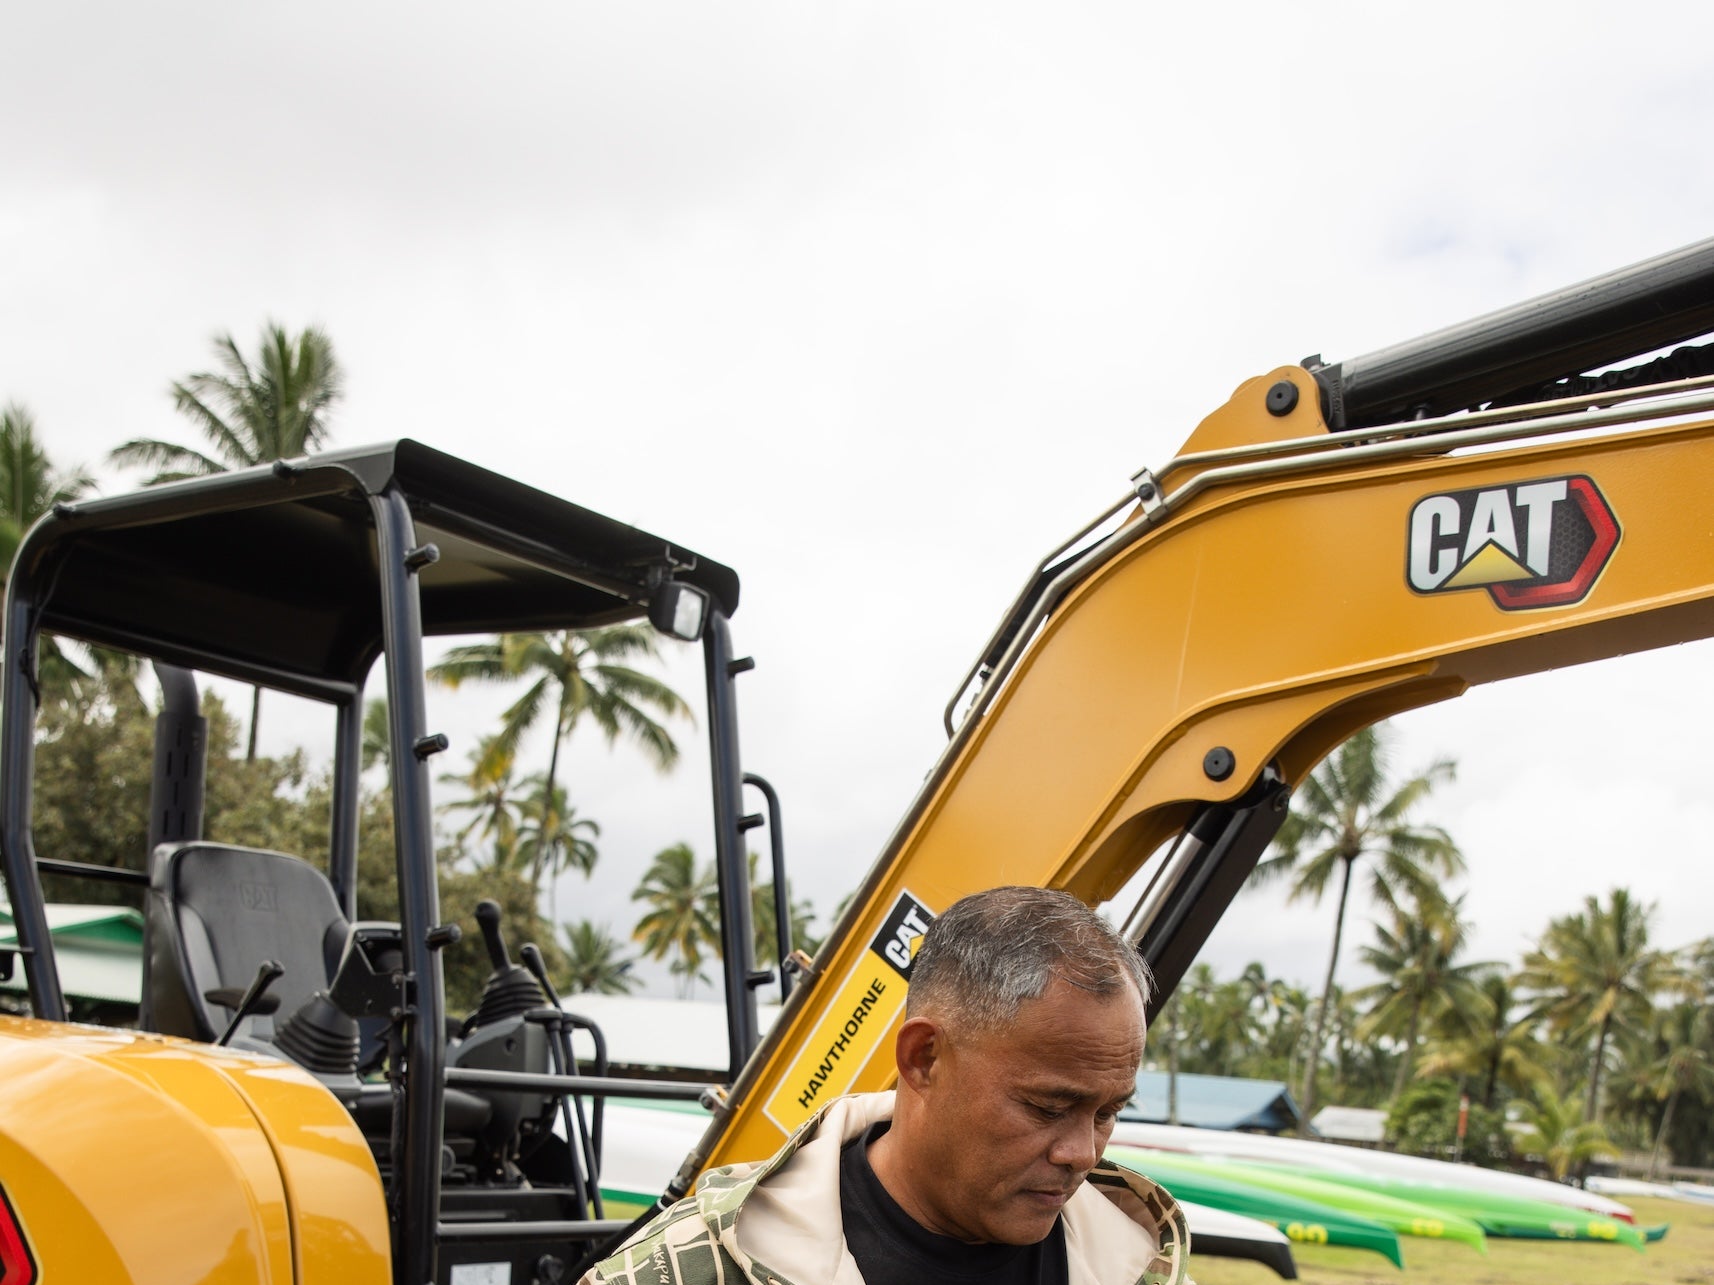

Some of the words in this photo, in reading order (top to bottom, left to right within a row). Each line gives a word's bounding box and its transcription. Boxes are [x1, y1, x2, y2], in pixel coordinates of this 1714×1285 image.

[1410, 480, 1567, 590] CAT
[885, 909, 929, 969] CAT
[798, 978, 886, 1109] HAWTHORNE
